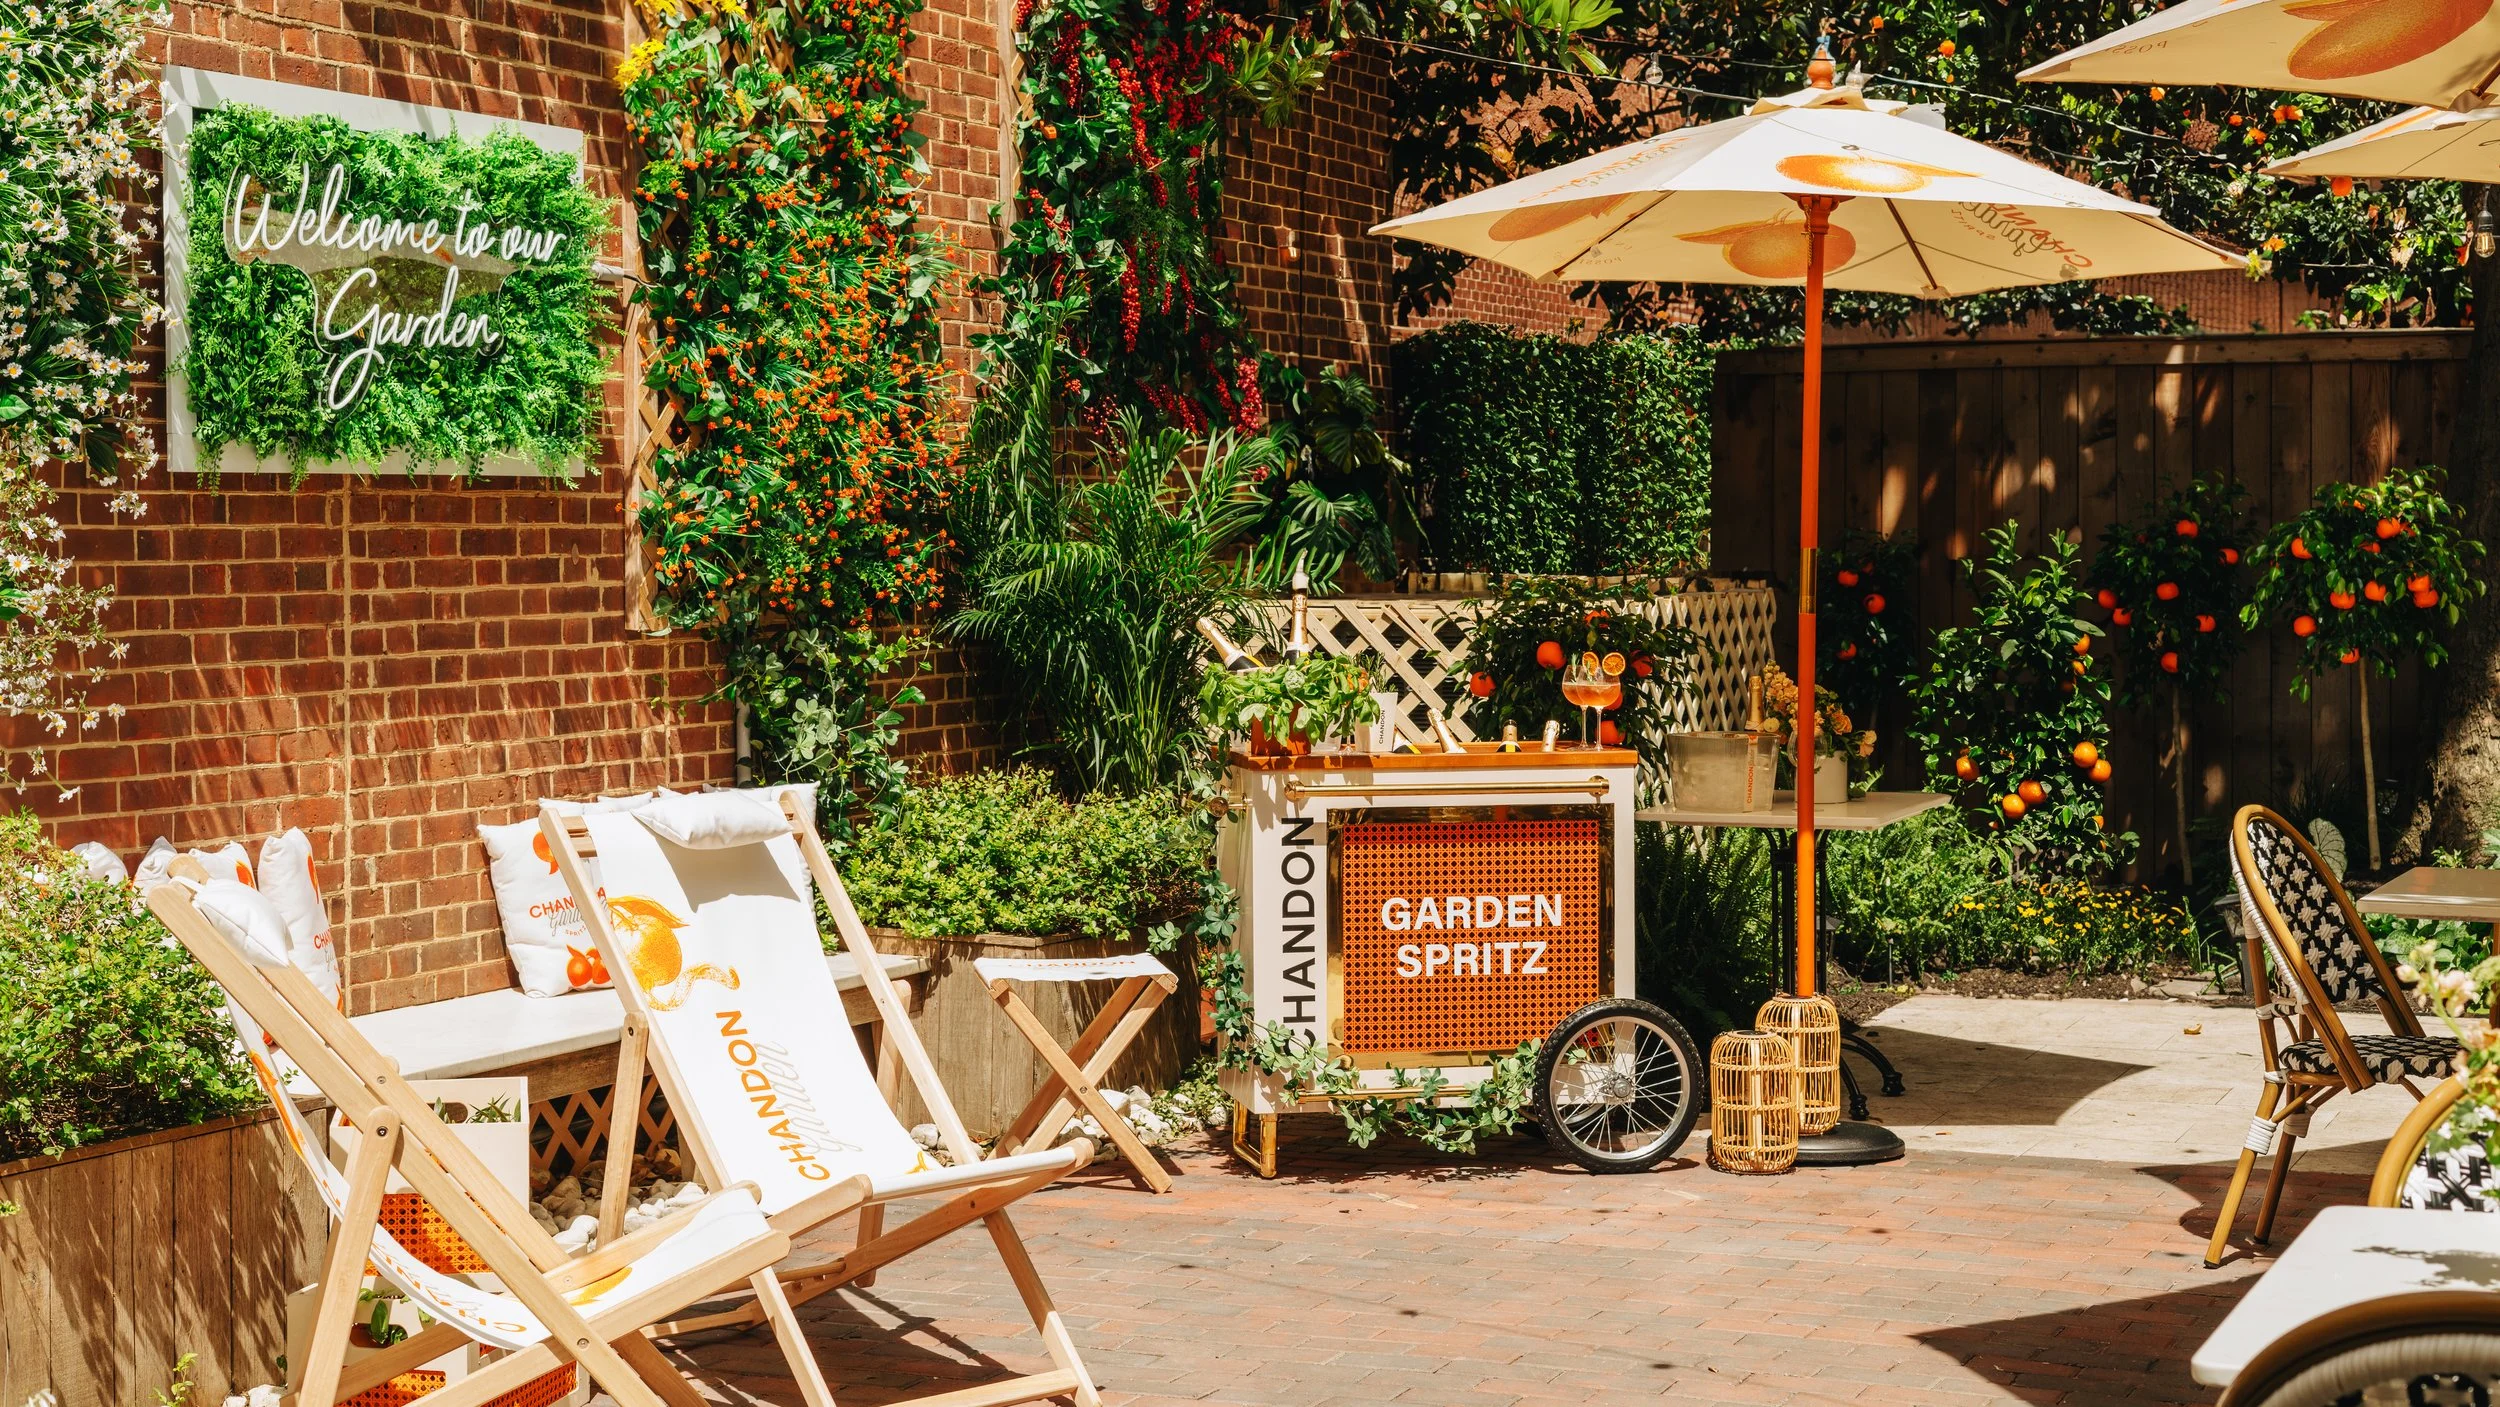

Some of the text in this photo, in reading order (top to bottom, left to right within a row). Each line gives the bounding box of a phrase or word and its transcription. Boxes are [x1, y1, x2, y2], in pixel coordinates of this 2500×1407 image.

[233, 161, 567, 262] Welcome to our
[323, 265, 499, 411] Garden
[1378, 709, 1386, 745] CHANDON
[1381, 894, 1562, 931] GARDEN
[1396, 941, 1548, 978] SPRITZ
[716, 1011, 831, 1181] CHANDON
